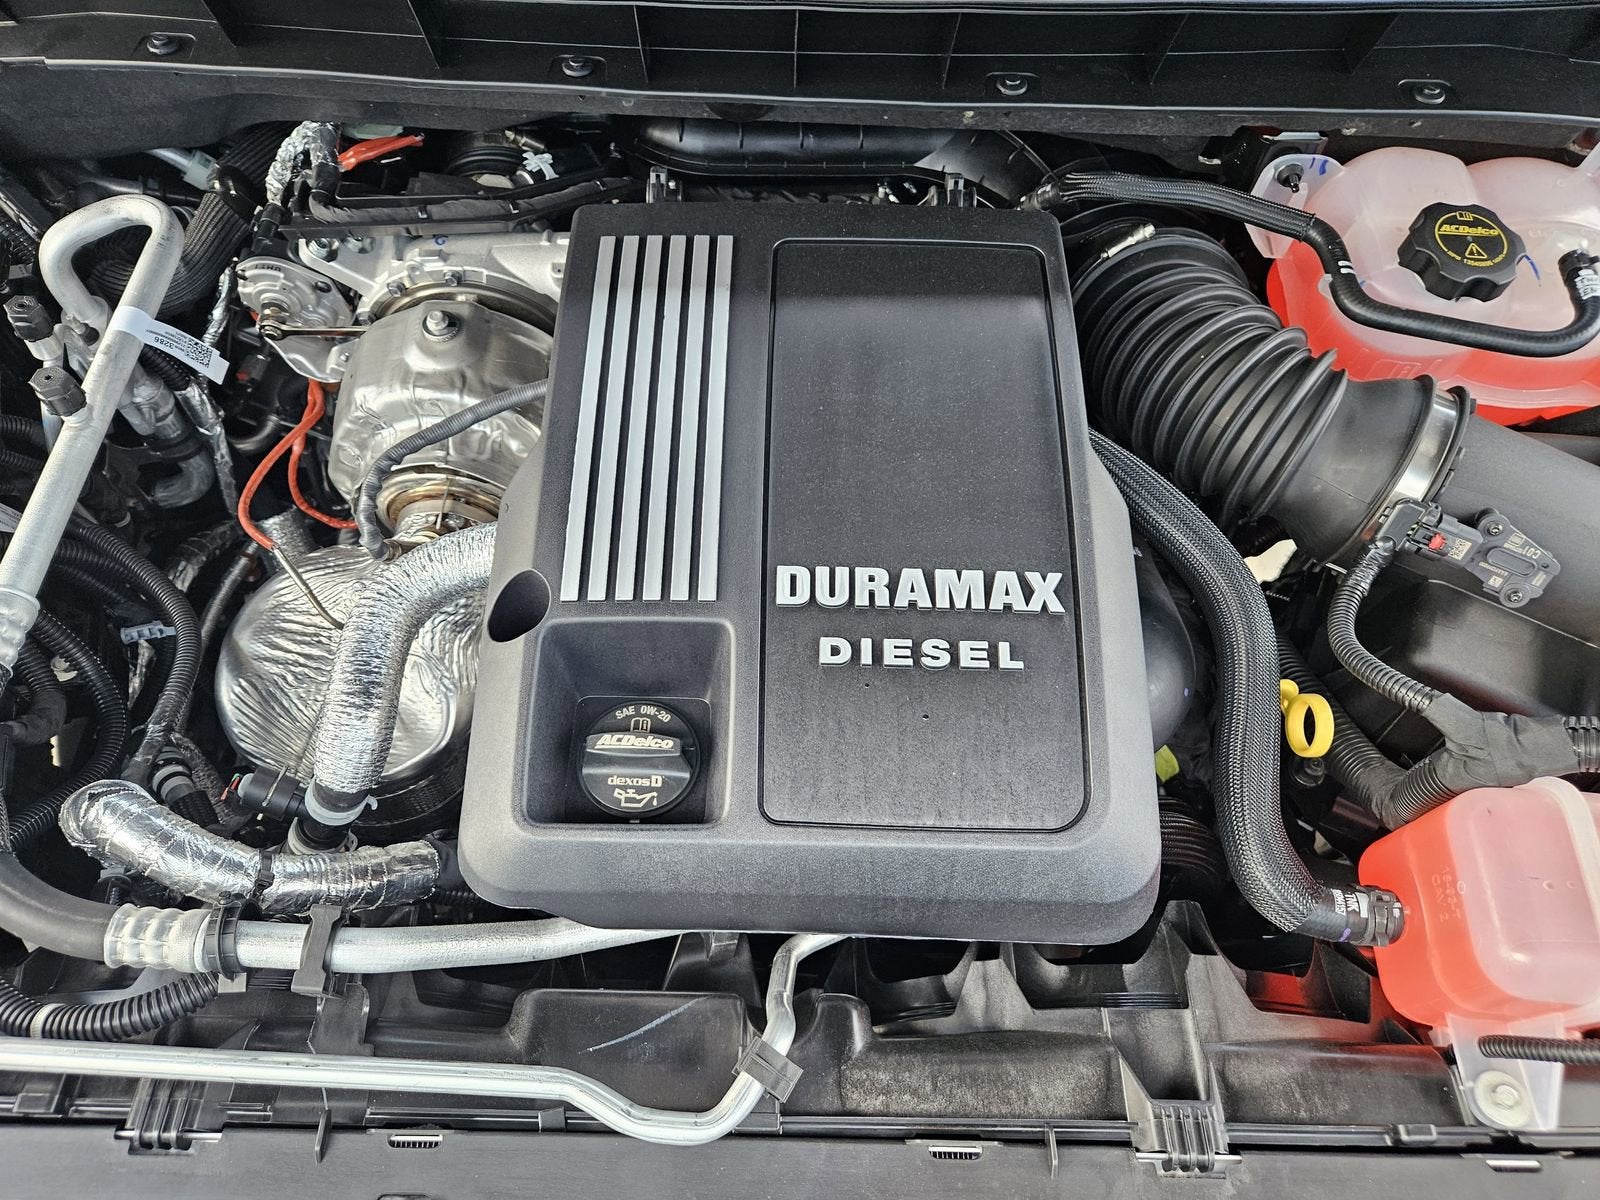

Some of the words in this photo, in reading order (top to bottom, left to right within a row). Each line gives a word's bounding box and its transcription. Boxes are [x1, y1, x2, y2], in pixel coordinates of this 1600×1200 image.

[1439, 224, 1500, 236] ACDelco
[154, 336, 175, 350] 3286
[1522, 545, 1541, 559] C01
[776, 565, 1066, 614] DURAMAX
[819, 636, 1024, 671] DIESEL
[615, 705, 636, 719] SAE
[640, 705, 672, 722] 0W-20
[594, 734, 674, 750] ACDelco
[1344, 892, 1360, 912] TNK
